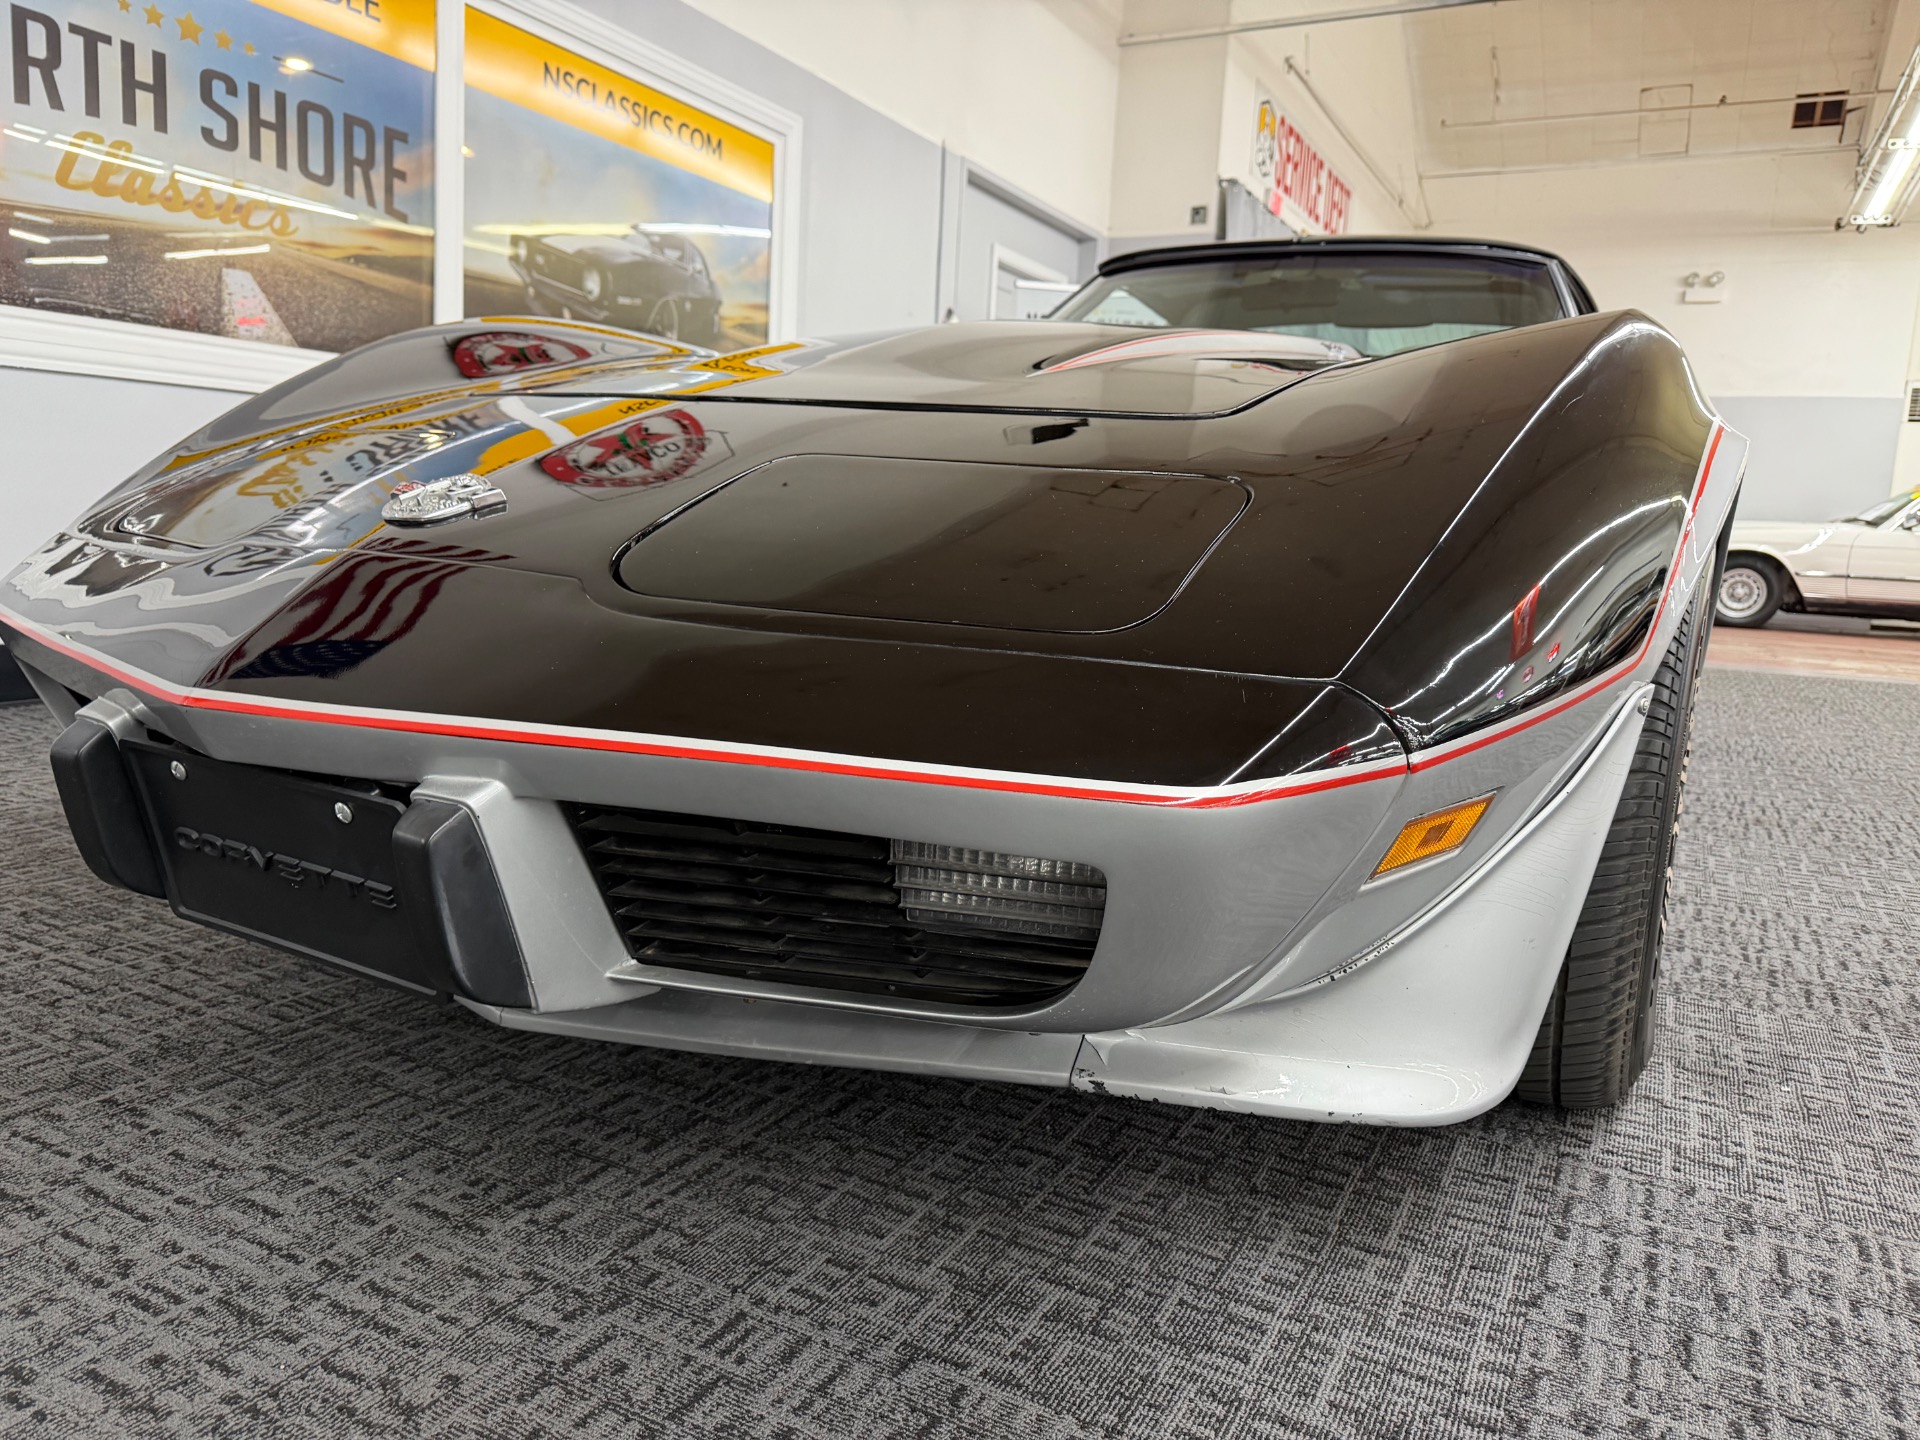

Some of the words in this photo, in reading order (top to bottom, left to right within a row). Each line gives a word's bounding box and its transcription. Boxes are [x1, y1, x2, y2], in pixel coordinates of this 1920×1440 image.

[10, 3, 168, 135] RTH
[200, 68, 409, 224] SHORE
[542, 61, 723, 161] NSCLASSICS.COM
[55, 131, 299, 236] Classics
[1275, 116, 1324, 222] SERVICE
[1324, 170, 1351, 235] LIFT
[175, 826, 397, 910] CORVETTE
